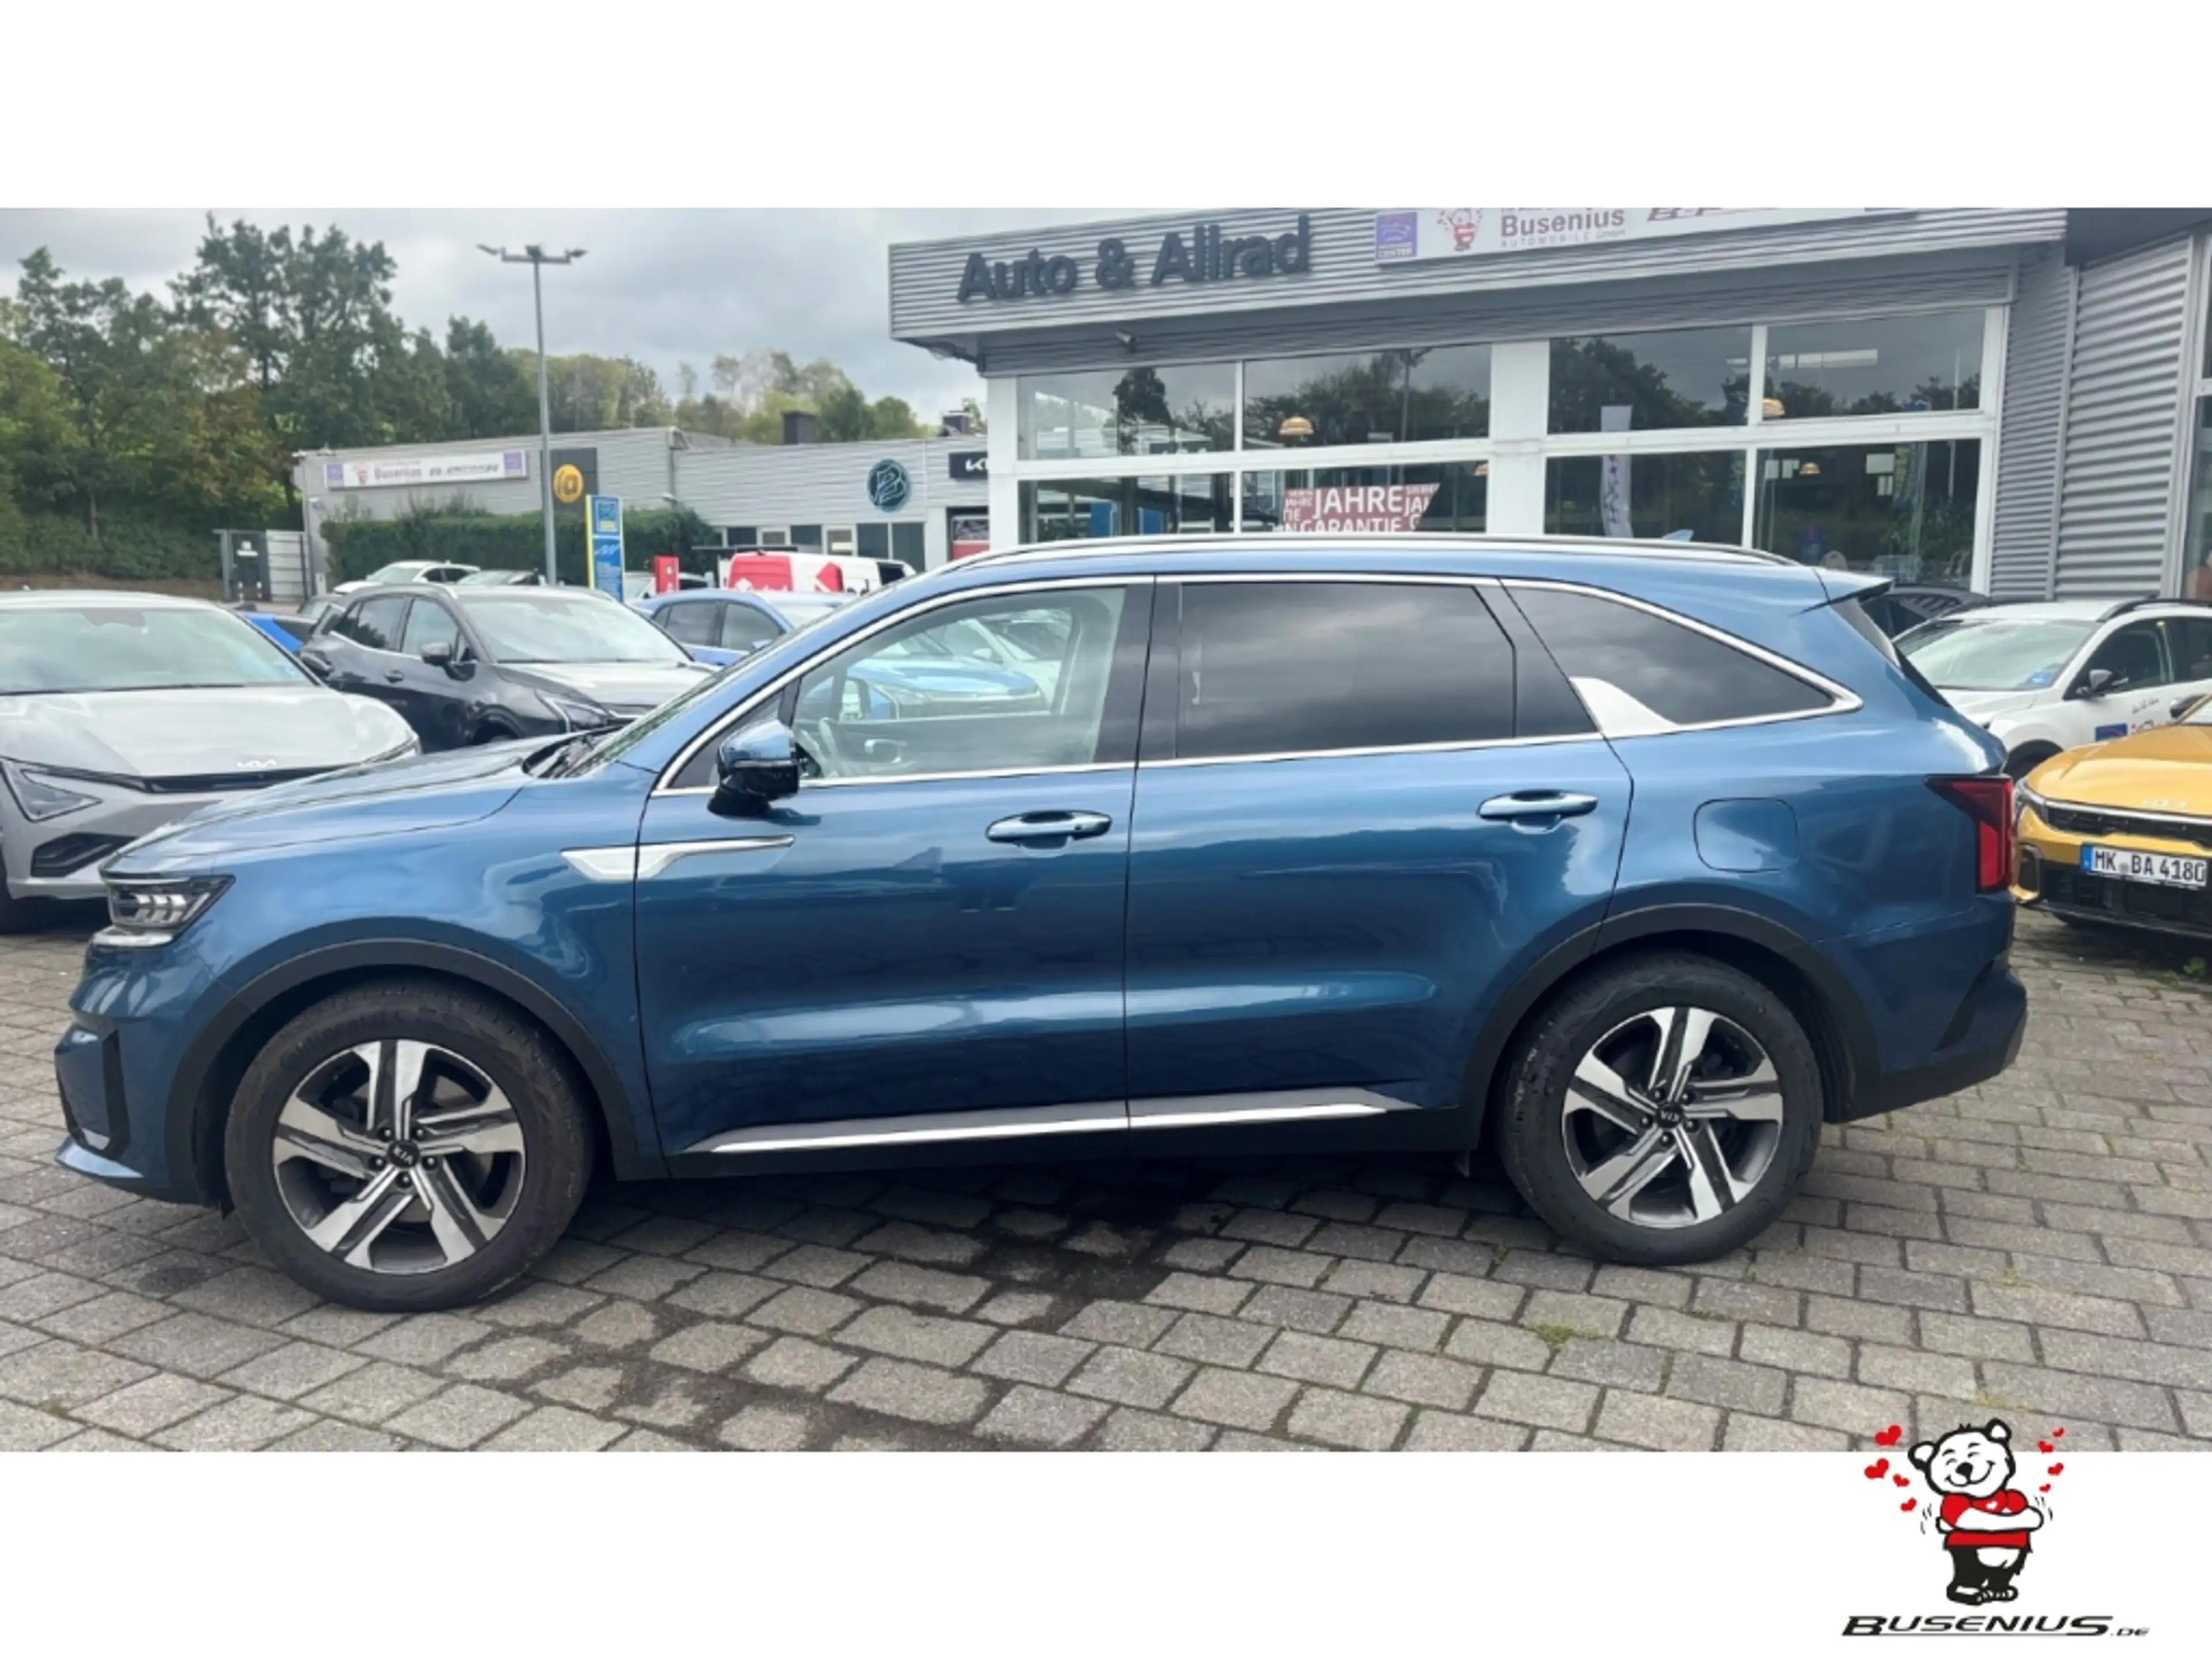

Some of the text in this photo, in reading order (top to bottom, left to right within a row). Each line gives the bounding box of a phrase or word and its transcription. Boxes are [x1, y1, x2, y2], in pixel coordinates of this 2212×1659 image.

[1501, 209, 1624, 237] Busenius
[956, 215, 1311, 303] Auto & Allrad
[1312, 486, 1403, 520] JAHRE
[2132, 855, 2154, 875] BA
[2160, 858, 2206, 882] 4180
